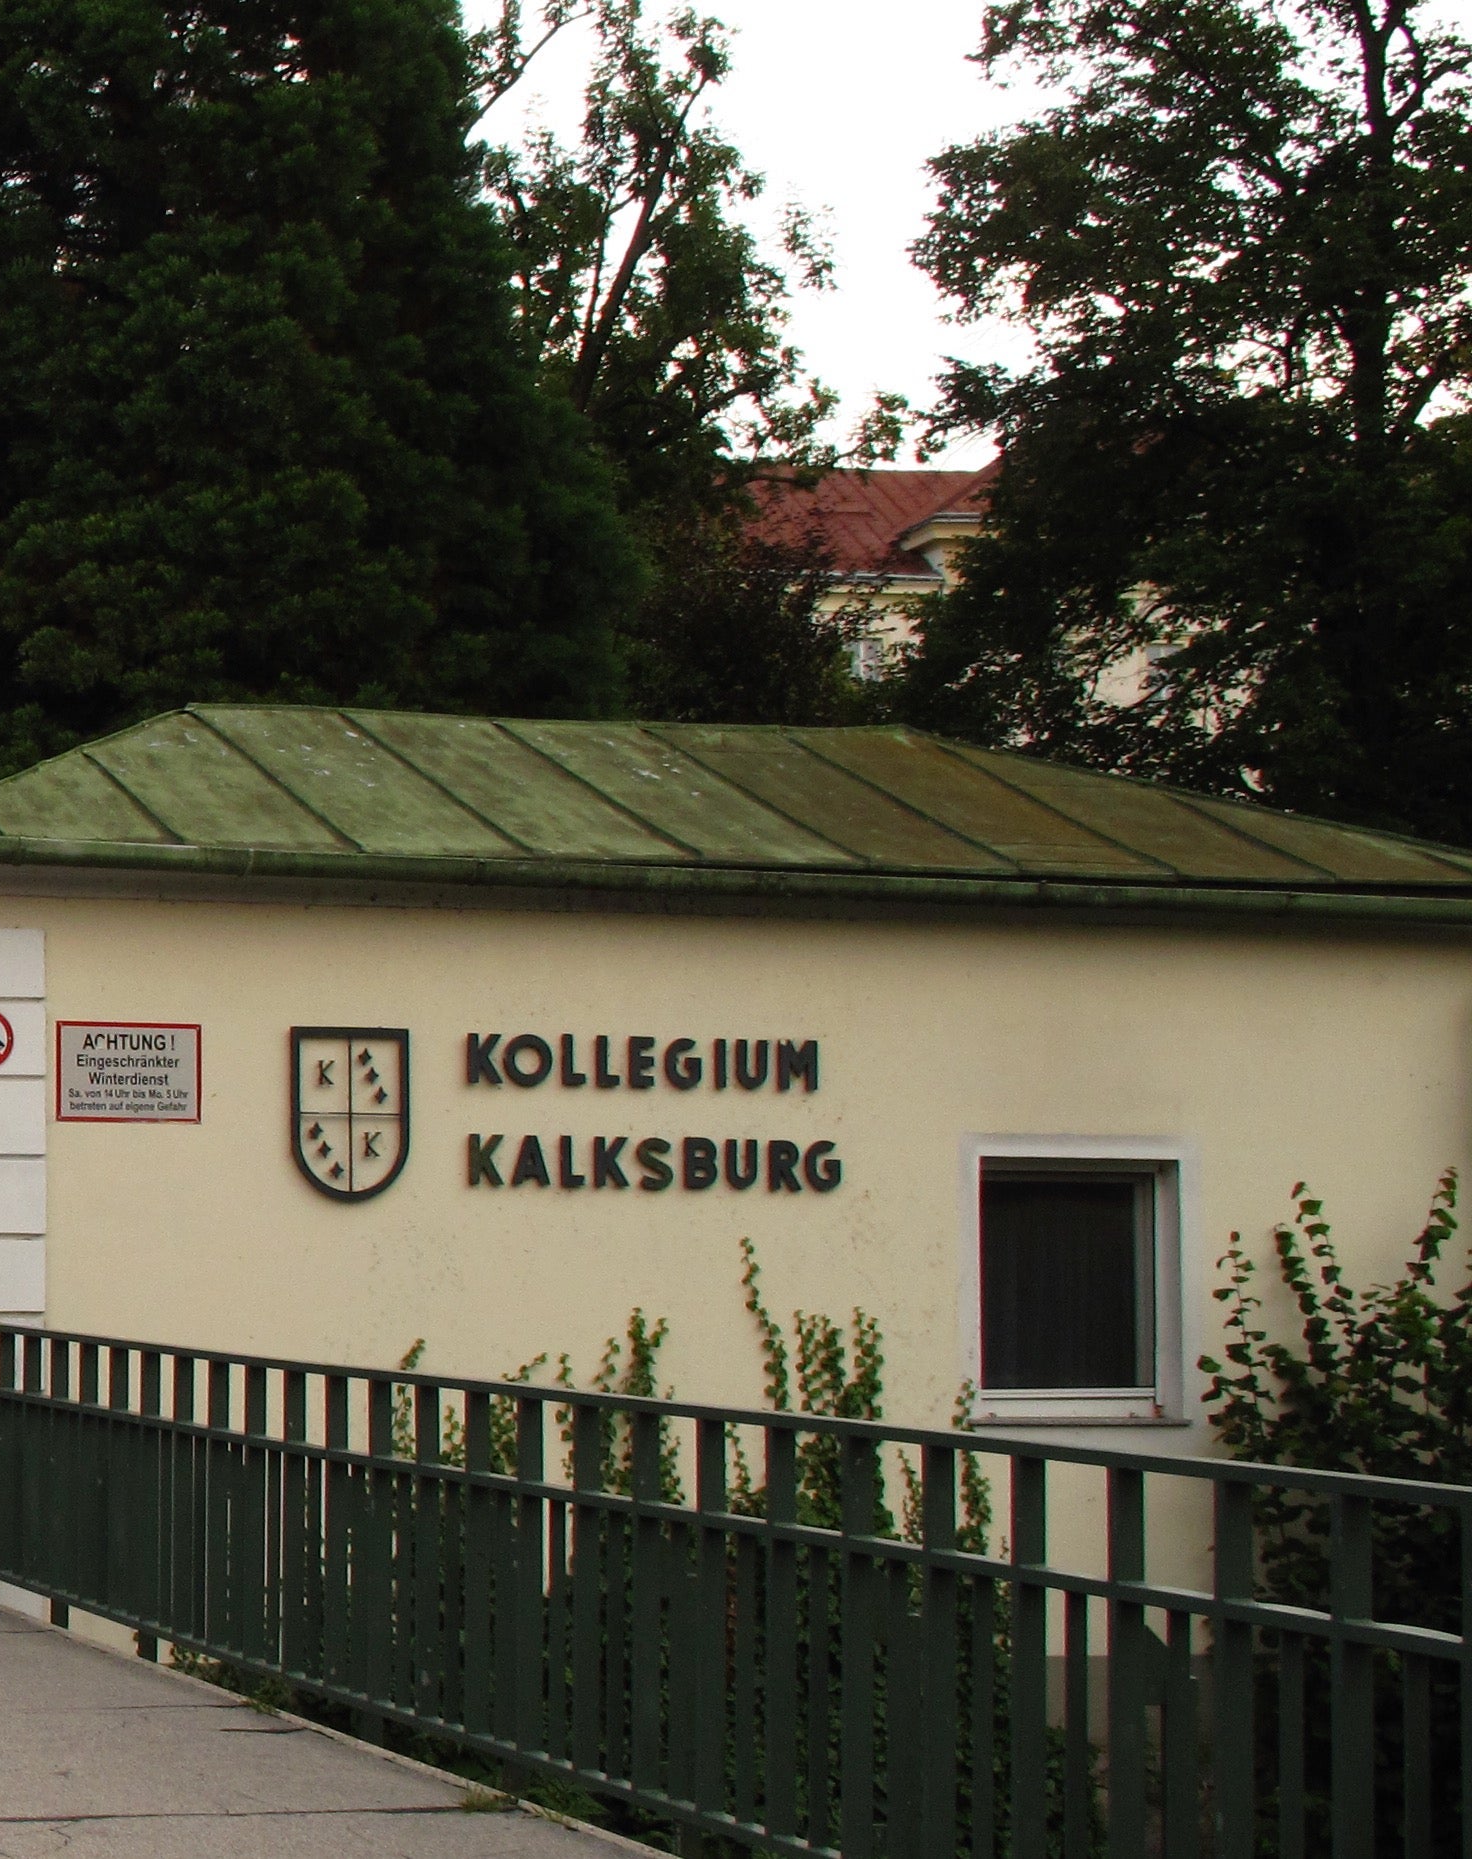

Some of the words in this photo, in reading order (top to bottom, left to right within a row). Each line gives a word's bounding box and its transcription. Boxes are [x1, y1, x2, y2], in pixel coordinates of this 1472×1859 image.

[76, 1054, 180, 1070] Eingeschränkter
[467, 1033, 818, 1092] KOLLEGIUM
[88, 1072, 169, 1086] Winterdienst
[318, 1060, 335, 1086] K
[68, 1088, 82, 1098] Sa.
[85, 1089, 102, 1098] von
[115, 1089, 130, 1098] Uhr
[132, 1089, 146, 1098] bis
[172, 1089, 188, 1099] Uhr
[69, 1101, 107, 1111] betreten
[109, 1102, 123, 1111] auf
[125, 1102, 155, 1113] eigene
[157, 1102, 188, 1112] Gefahr
[364, 1132, 383, 1158] K
[468, 1134, 842, 1192] KALKSBURG
